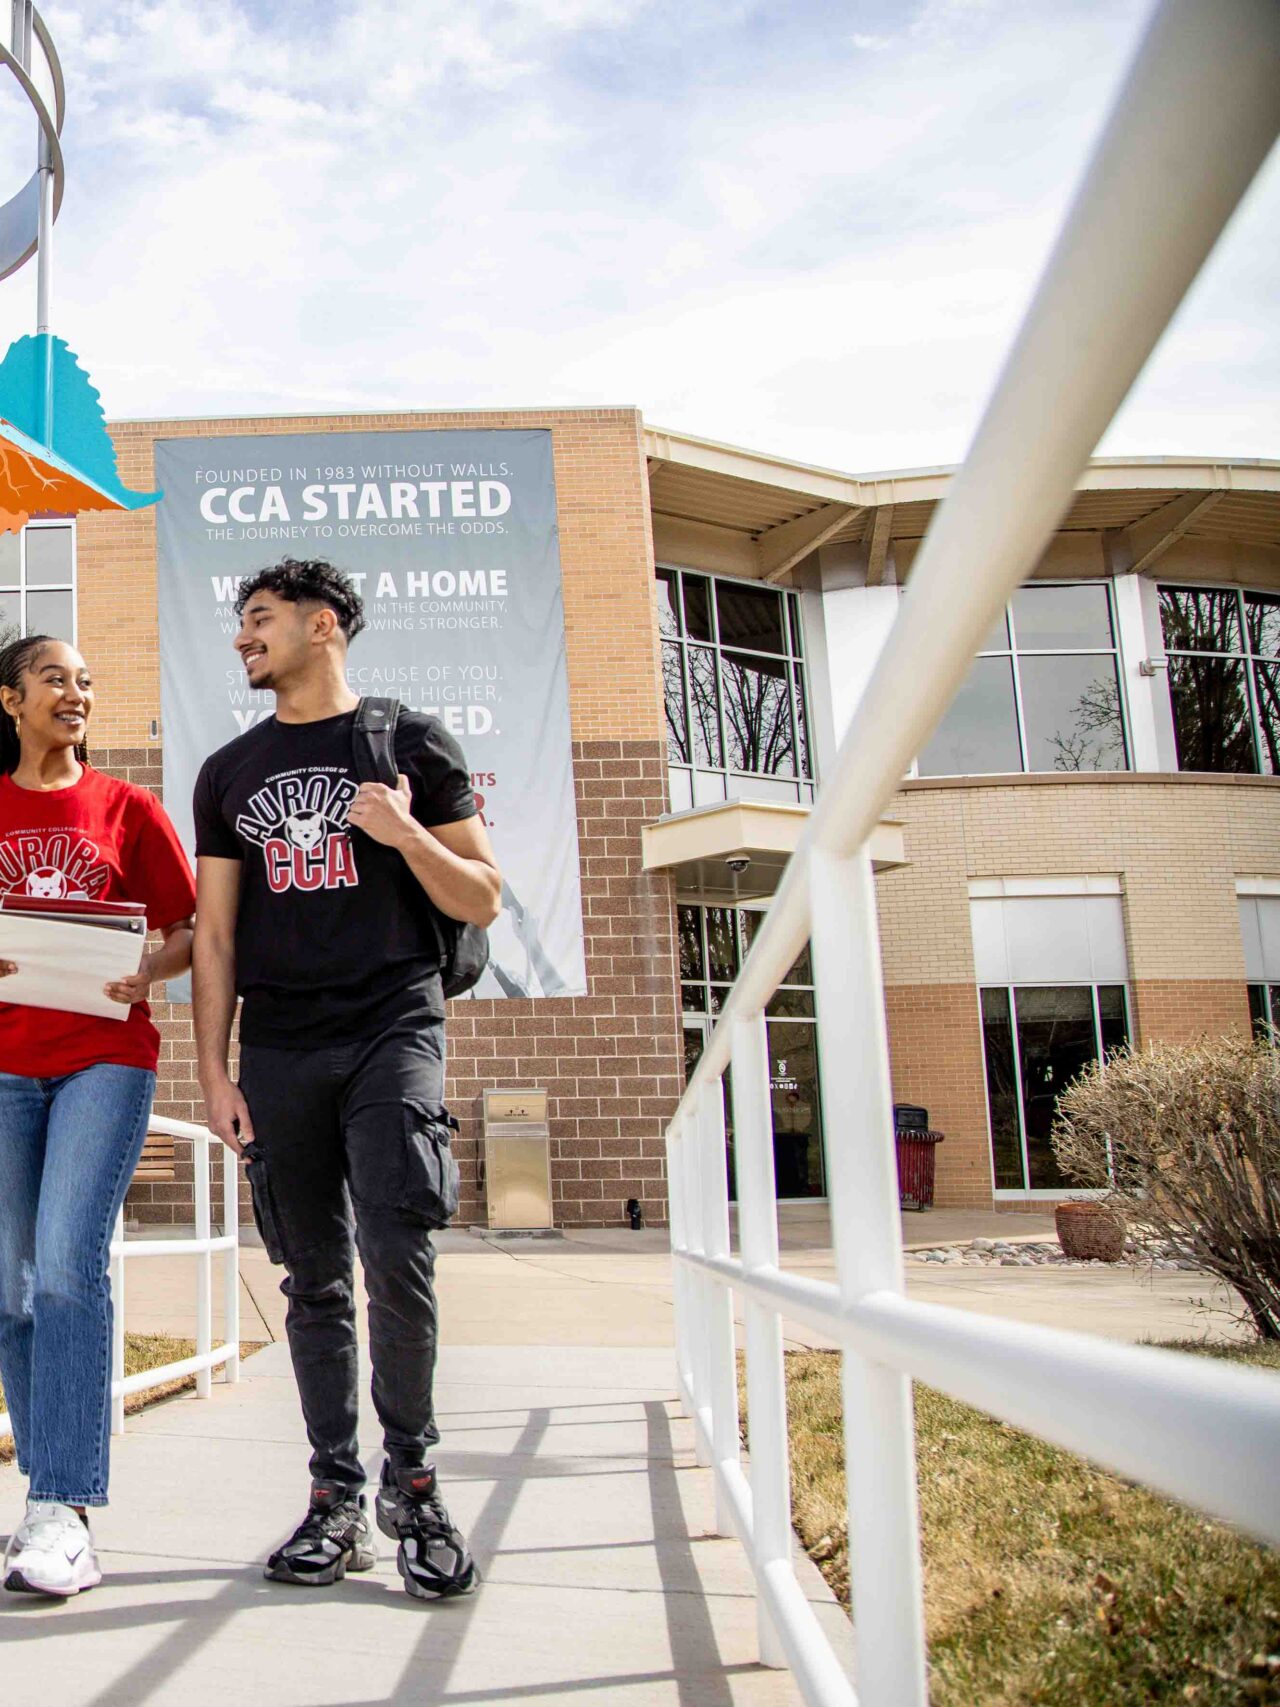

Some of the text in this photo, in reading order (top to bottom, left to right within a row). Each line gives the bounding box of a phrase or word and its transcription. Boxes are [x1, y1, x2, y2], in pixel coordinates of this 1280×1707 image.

[195, 462, 514, 484] FOUNDED IN 1983 WITHOUT WALLS.
[199, 480, 512, 524] CCA STARTED
[205, 521, 509, 541] THE JOURNEY TO OVERCOME THE ODDS.
[375, 572, 399, 598] A
[406, 569, 508, 598] HOME
[373, 602, 387, 614] IN
[391, 601, 417, 614] THE
[420, 600, 508, 613] COMMUNITY,
[419, 616, 503, 630] STRONGER.
[346, 665, 504, 683] ECAUSE OF YOU.
[228, 689, 273, 705] WHE
[421, 685, 503, 703] HIGHER,
[265, 768, 307, 783] COMMUNITY
[235, 774, 360, 848] AUROR
[5, 827, 46, 837] COMMUNITY
[263, 831, 359, 893] CCA
